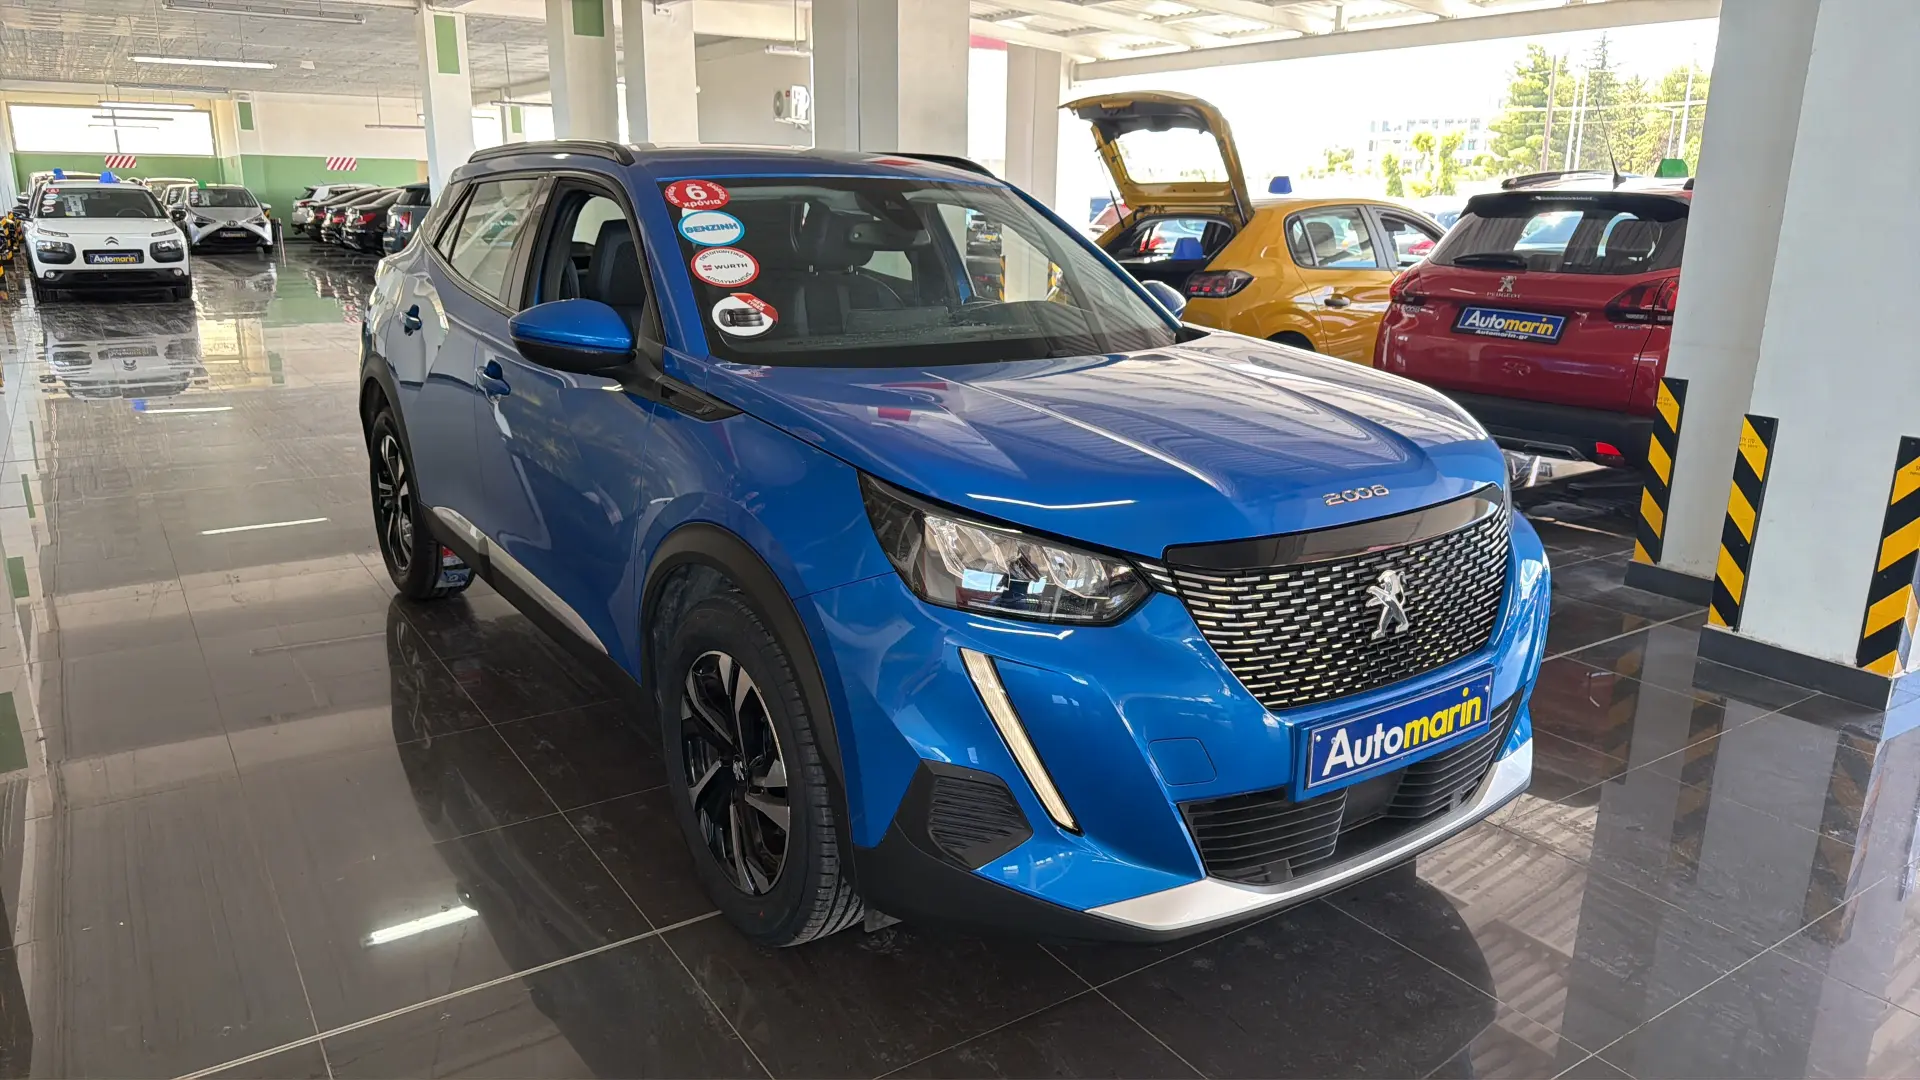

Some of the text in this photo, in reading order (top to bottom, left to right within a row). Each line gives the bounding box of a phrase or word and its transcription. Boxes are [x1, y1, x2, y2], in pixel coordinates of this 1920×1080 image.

[685, 185, 708, 201] 6
[683, 199, 722, 208] χρόνια
[93, 254, 136, 263] Automarin
[1464, 310, 1554, 336] Automarin
[1475, 329, 1528, 340] Automarin.gr
[1322, 484, 1390, 506] 2008
[1321, 686, 1482, 777] Automarin
